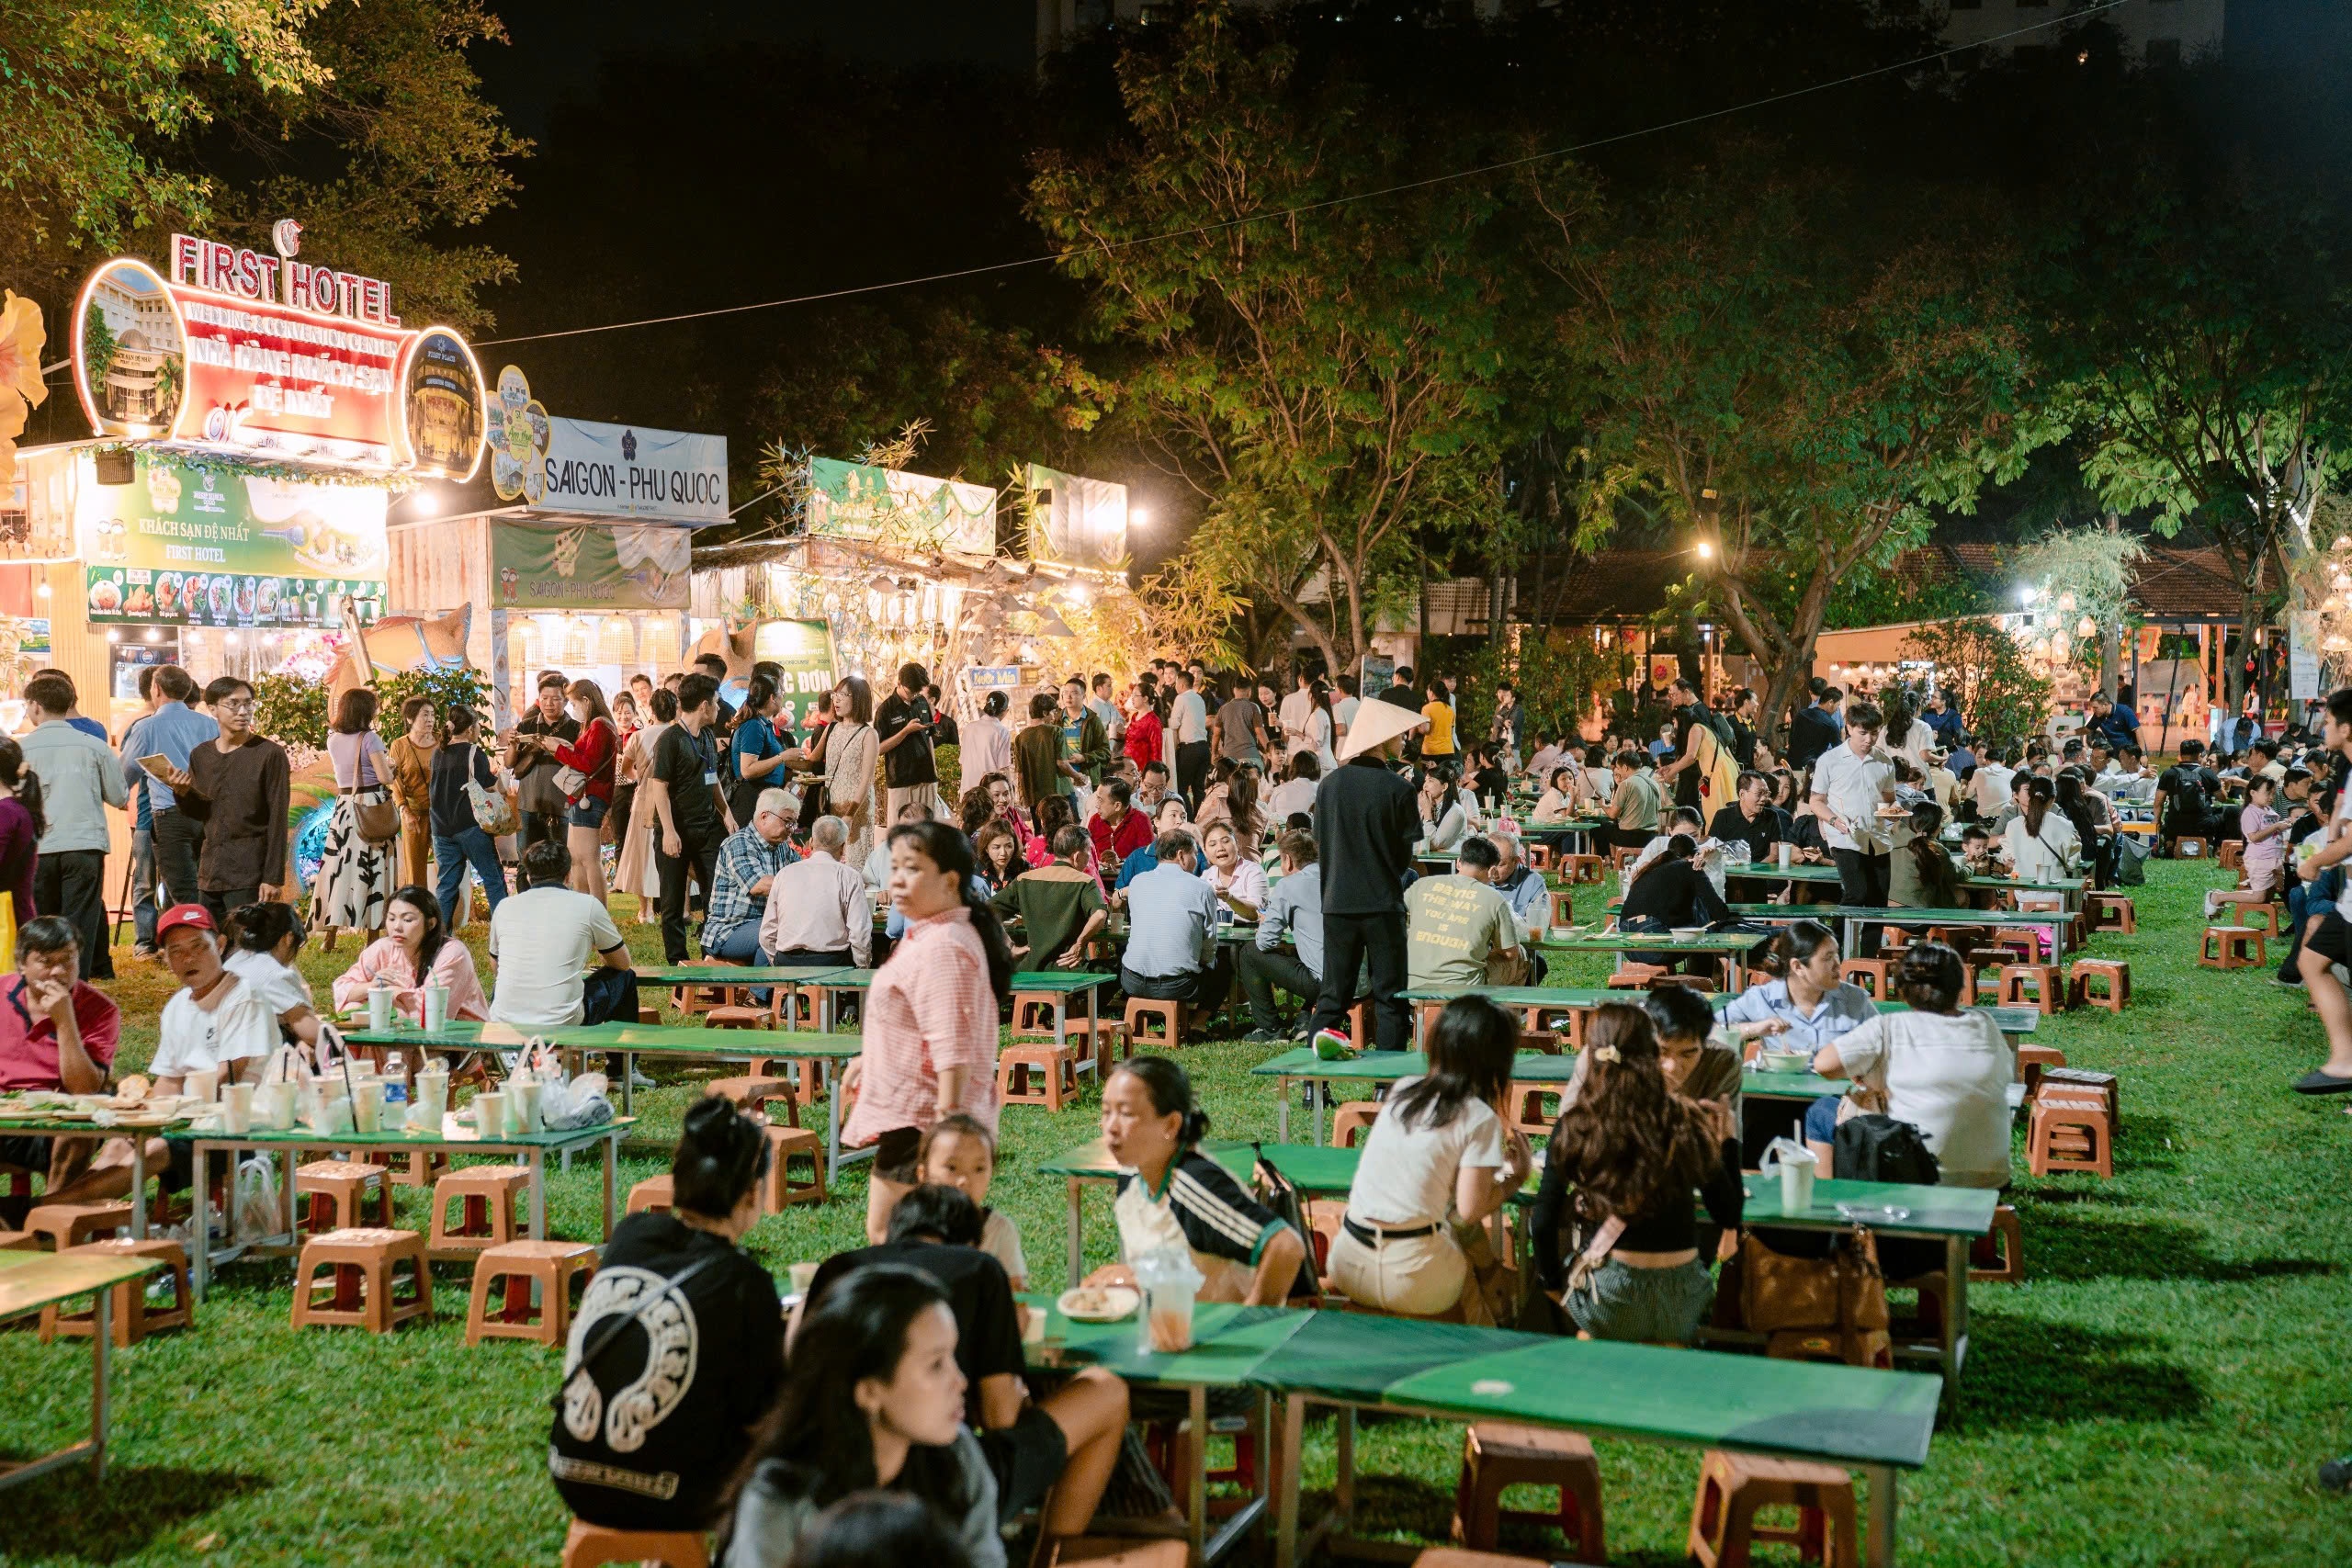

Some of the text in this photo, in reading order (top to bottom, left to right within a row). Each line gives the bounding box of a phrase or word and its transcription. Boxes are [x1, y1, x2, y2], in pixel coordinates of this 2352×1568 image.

[172, 233, 401, 329] FIRST HOTEL
[187, 302, 251, 332] WEDDING
[263, 317, 346, 350] CONVENTION
[347, 333, 397, 357] CENTER
[545, 457, 616, 497] SAIGON
[629, 467, 665, 501] PHU
[671, 470, 720, 505] QUOC
[139, 516, 250, 543] KHÁCH SẠN ĐỆ NHẤT
[166, 544, 226, 562] FIRST HOTEL
[529, 581, 564, 598] SAIGON
[571, 582, 588, 599] PHU
[591, 583, 616, 600] QUOC
[1422, 893, 1481, 913] THE WAY
[1425, 908, 1470, 925] YOU ARE
[1437, 923, 1449, 932] IS
[1415, 931, 1470, 950] ENOUGH
